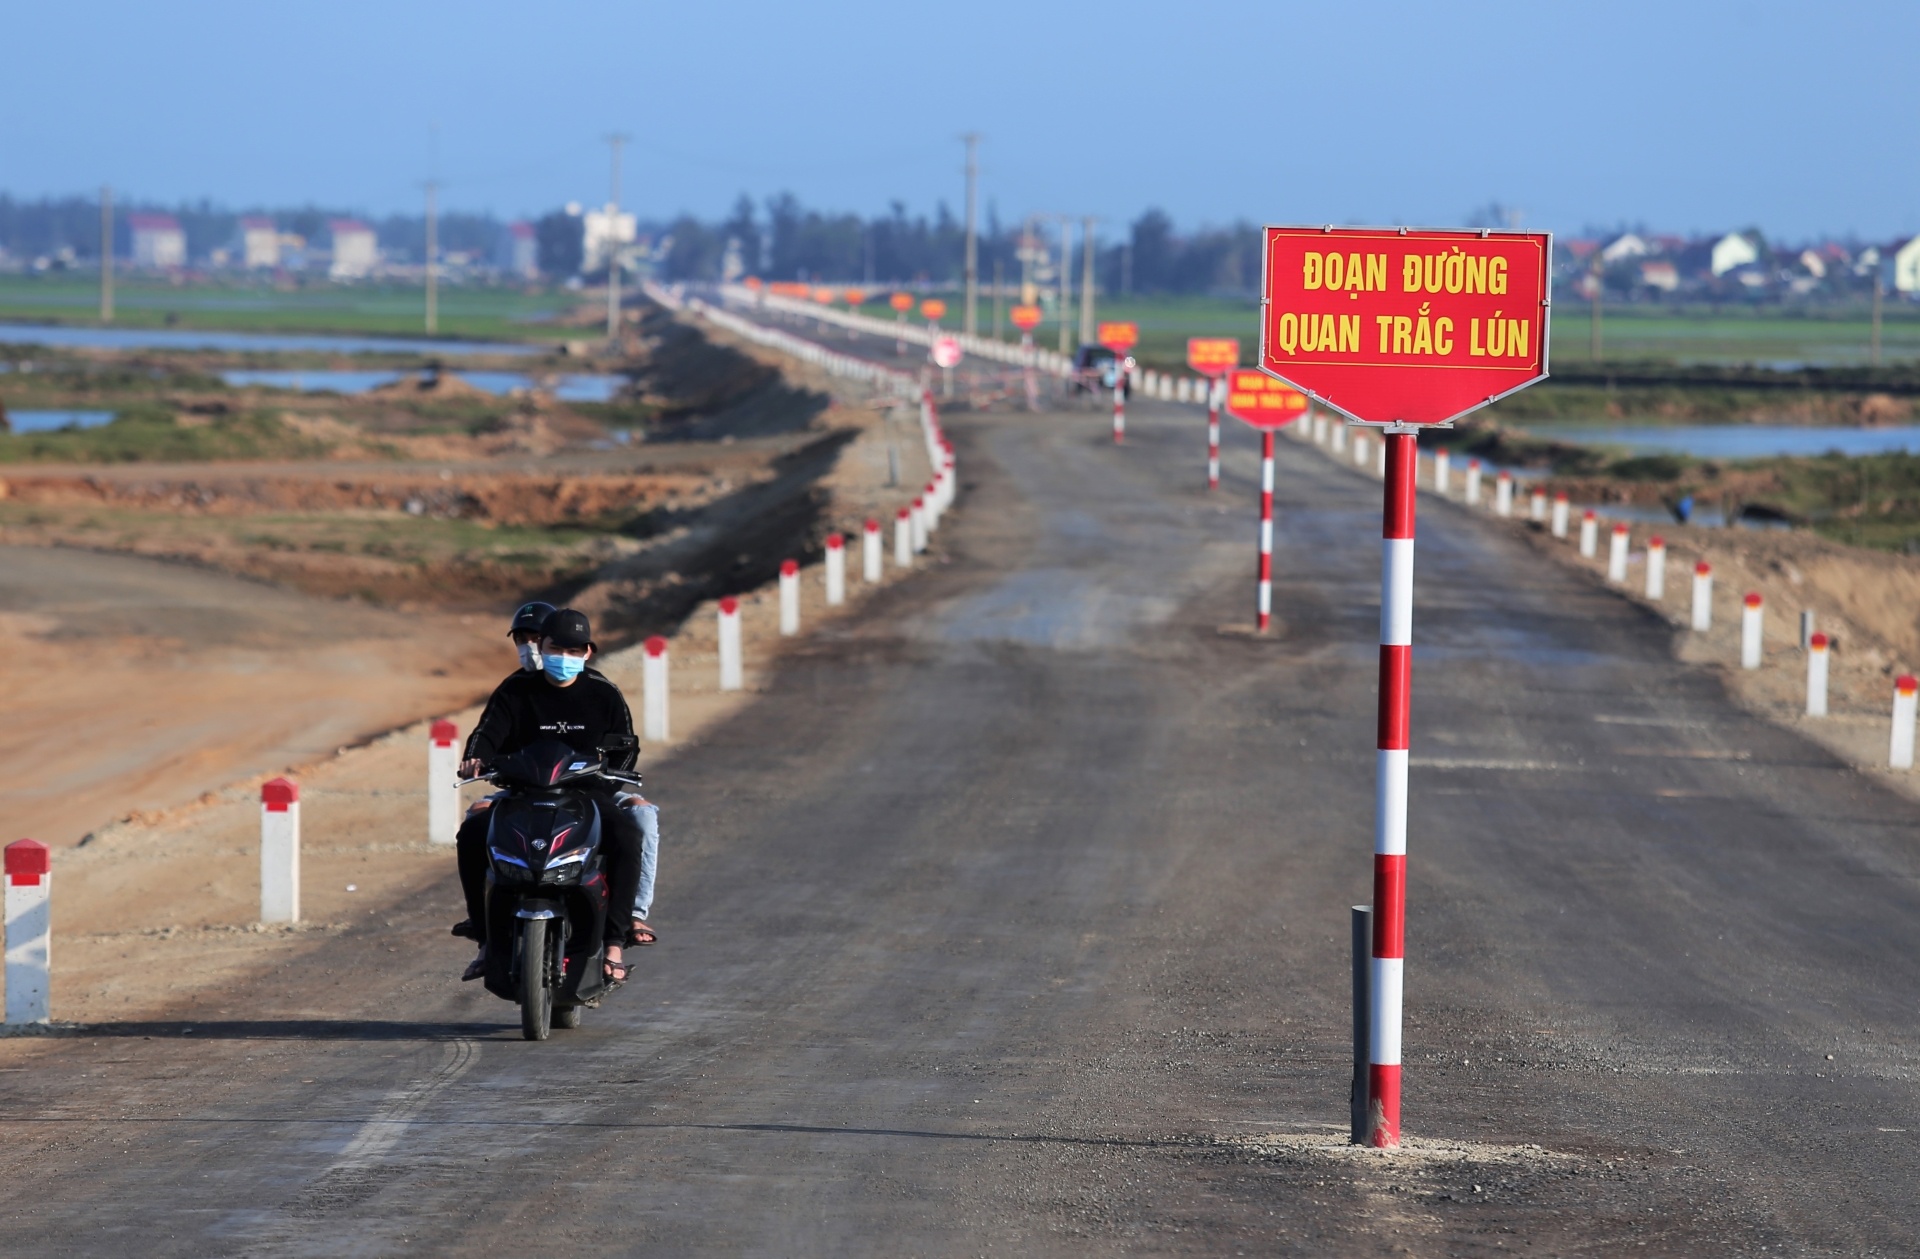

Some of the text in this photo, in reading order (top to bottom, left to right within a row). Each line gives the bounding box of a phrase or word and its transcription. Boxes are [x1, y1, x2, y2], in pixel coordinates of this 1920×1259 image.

[1303, 246, 1507, 299] ĐOẠN ĐƯỜNG
[1279, 302, 1529, 358] QUAN TRẮC LÚN
